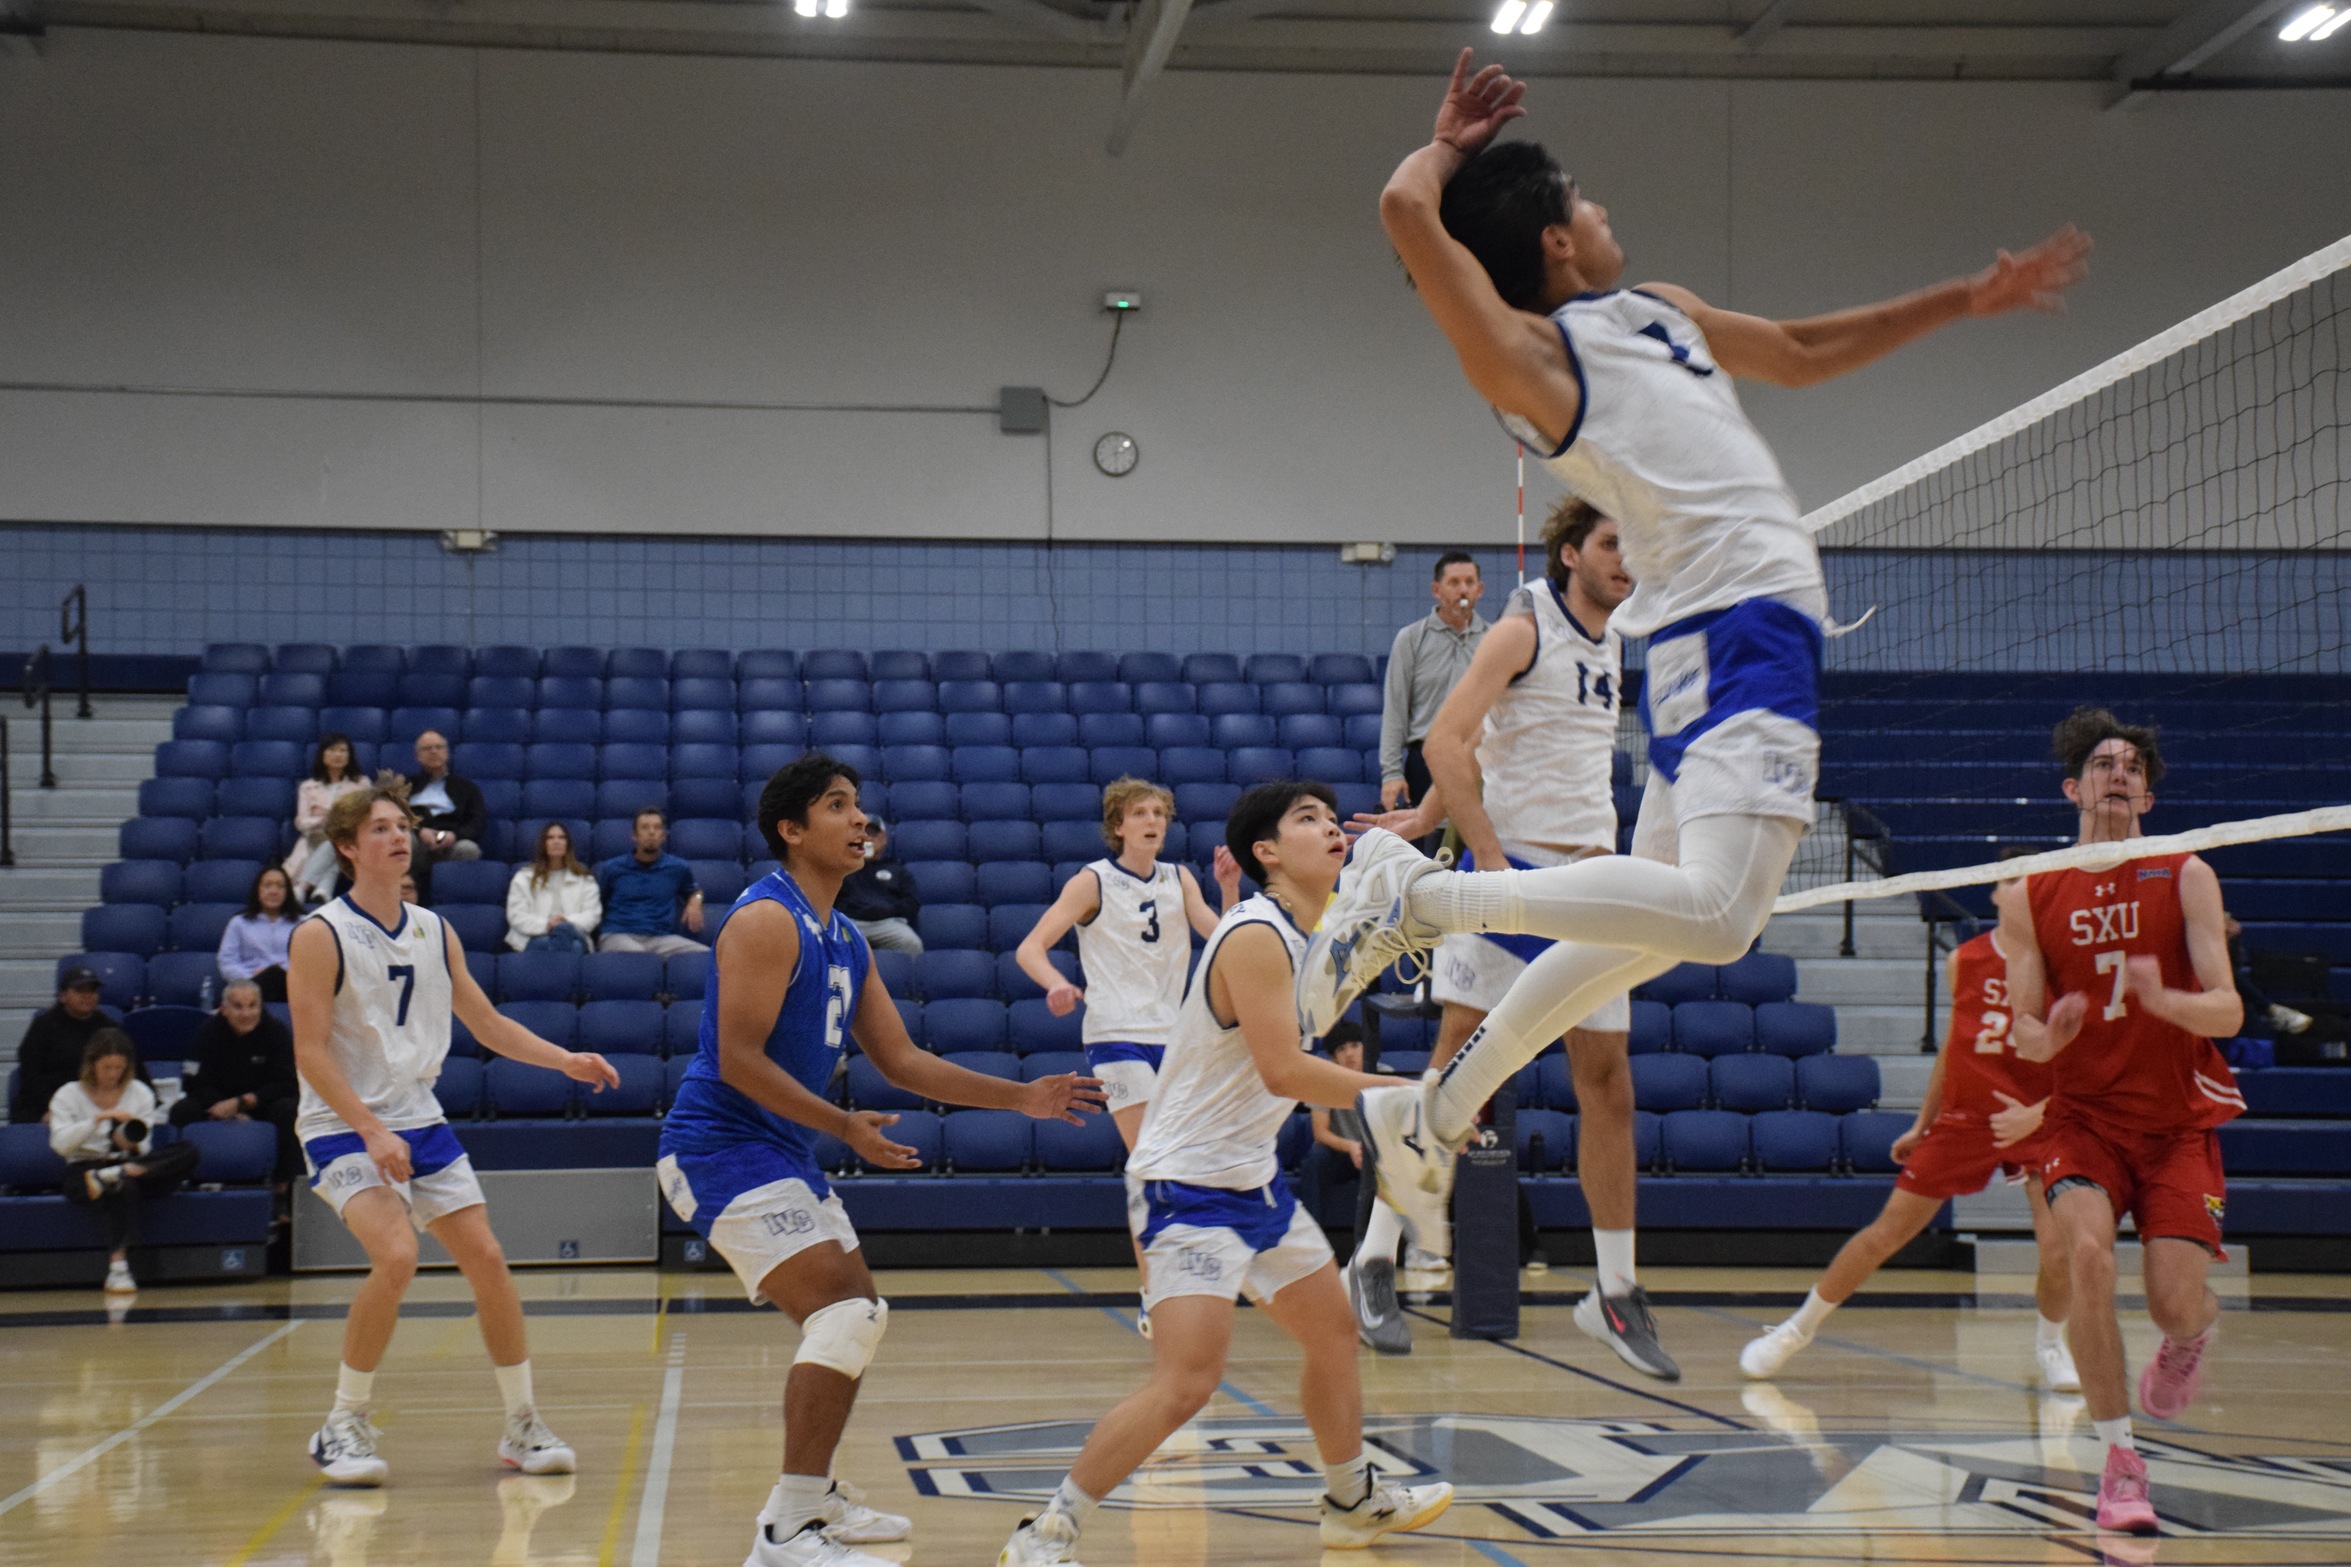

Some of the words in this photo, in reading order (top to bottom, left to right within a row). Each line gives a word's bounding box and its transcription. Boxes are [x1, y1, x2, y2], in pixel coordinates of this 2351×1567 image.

[1575, 661, 1614, 710] 14
[1139, 899, 1160, 943] 3
[2069, 901, 2140, 946] SXU
[388, 964, 415, 1026] 7
[2094, 949, 2127, 1021] 7
